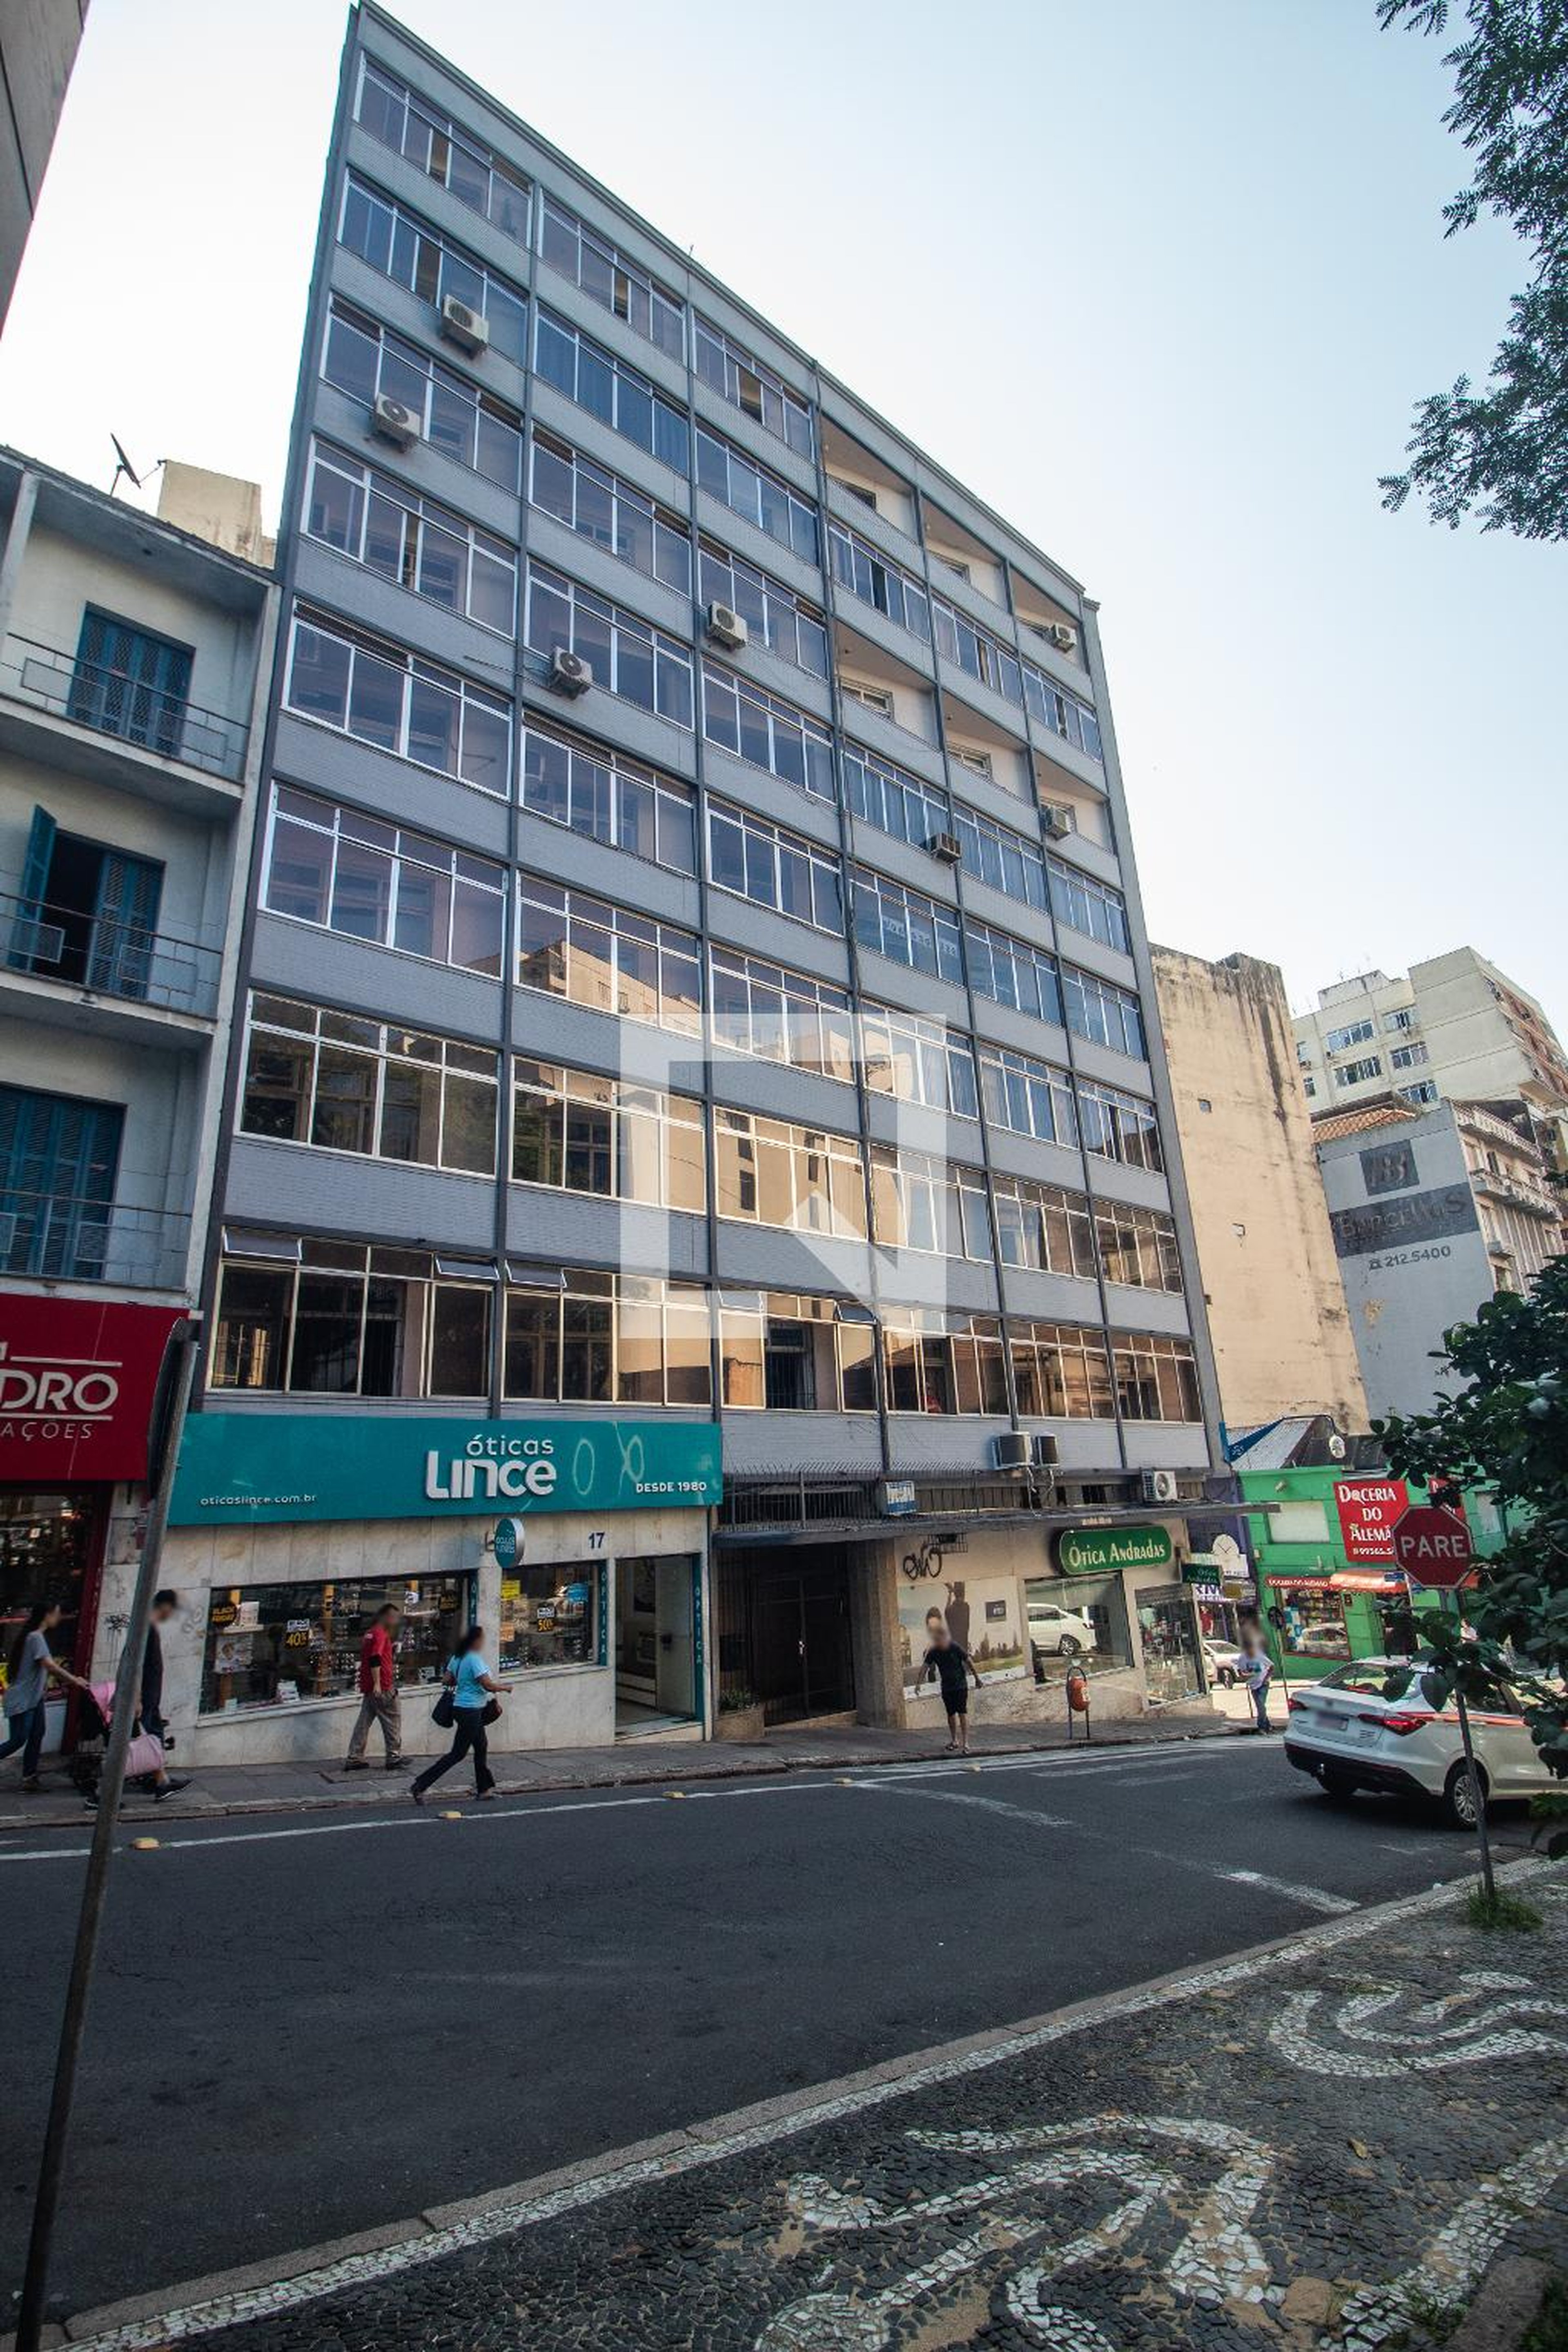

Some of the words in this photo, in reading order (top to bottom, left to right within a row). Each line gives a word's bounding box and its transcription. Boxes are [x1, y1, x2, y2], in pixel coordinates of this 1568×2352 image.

[1385, 1246, 1451, 1267] 212.5400
[466, 1434, 554, 1455] óticas
[636, 1482, 674, 1493] DESDE
[677, 1481, 707, 1492] 1980
[200, 1494, 316, 1505] oticaslince.com.br
[1362, 1506, 1382, 1521] DO
[588, 1532, 605, 1549] 17
[1400, 1535, 1468, 1558] PARE
